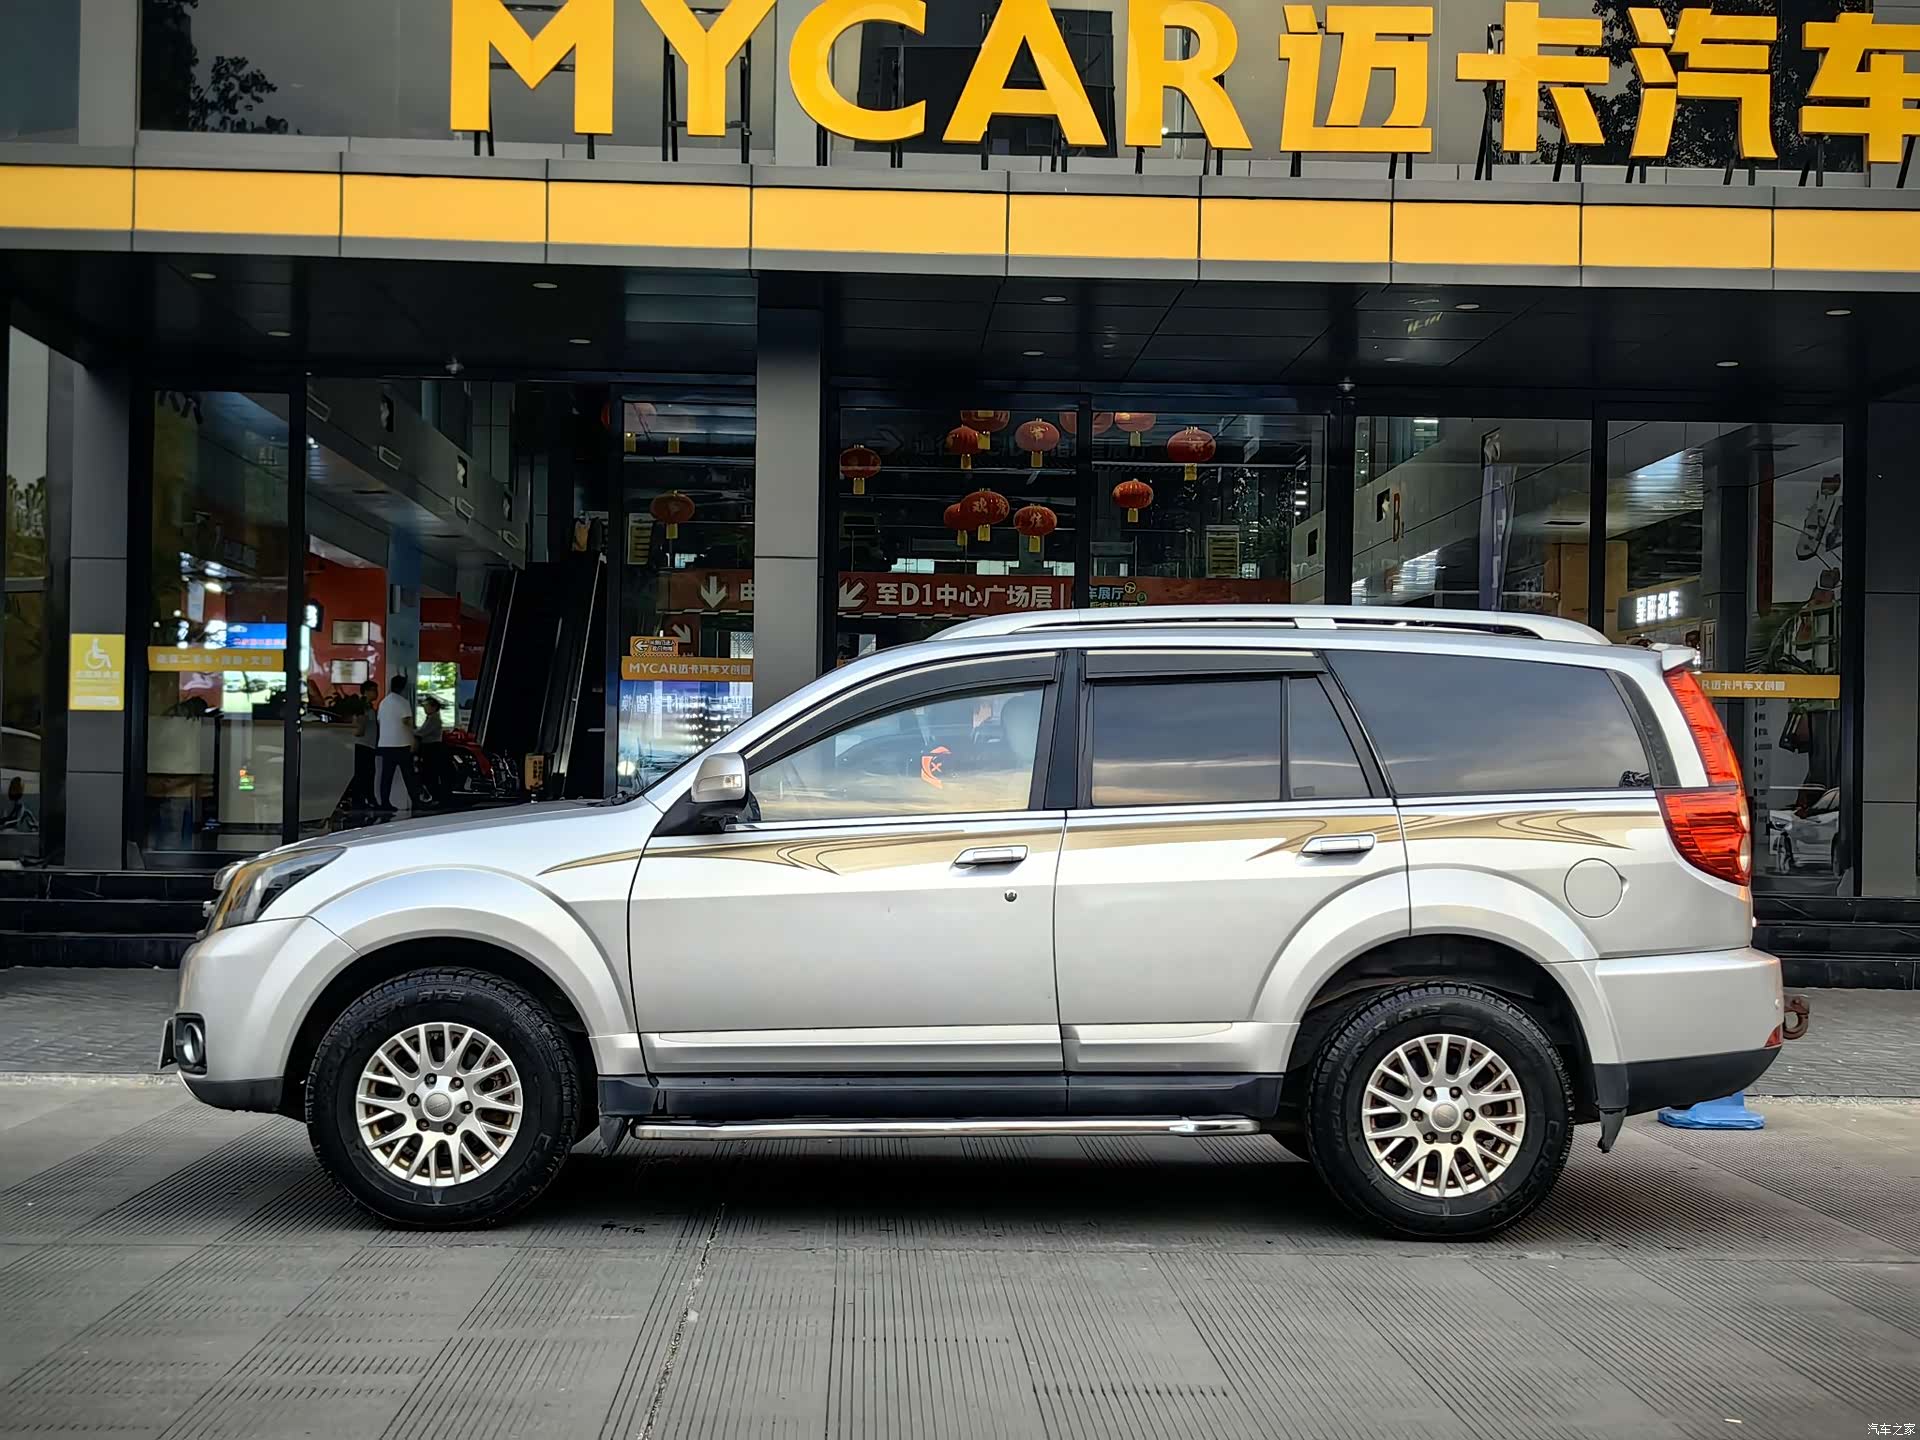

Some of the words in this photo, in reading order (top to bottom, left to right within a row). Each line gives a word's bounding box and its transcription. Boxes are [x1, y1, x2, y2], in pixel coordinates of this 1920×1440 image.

[876, 583, 1052, 608] 至D1中心广场层
